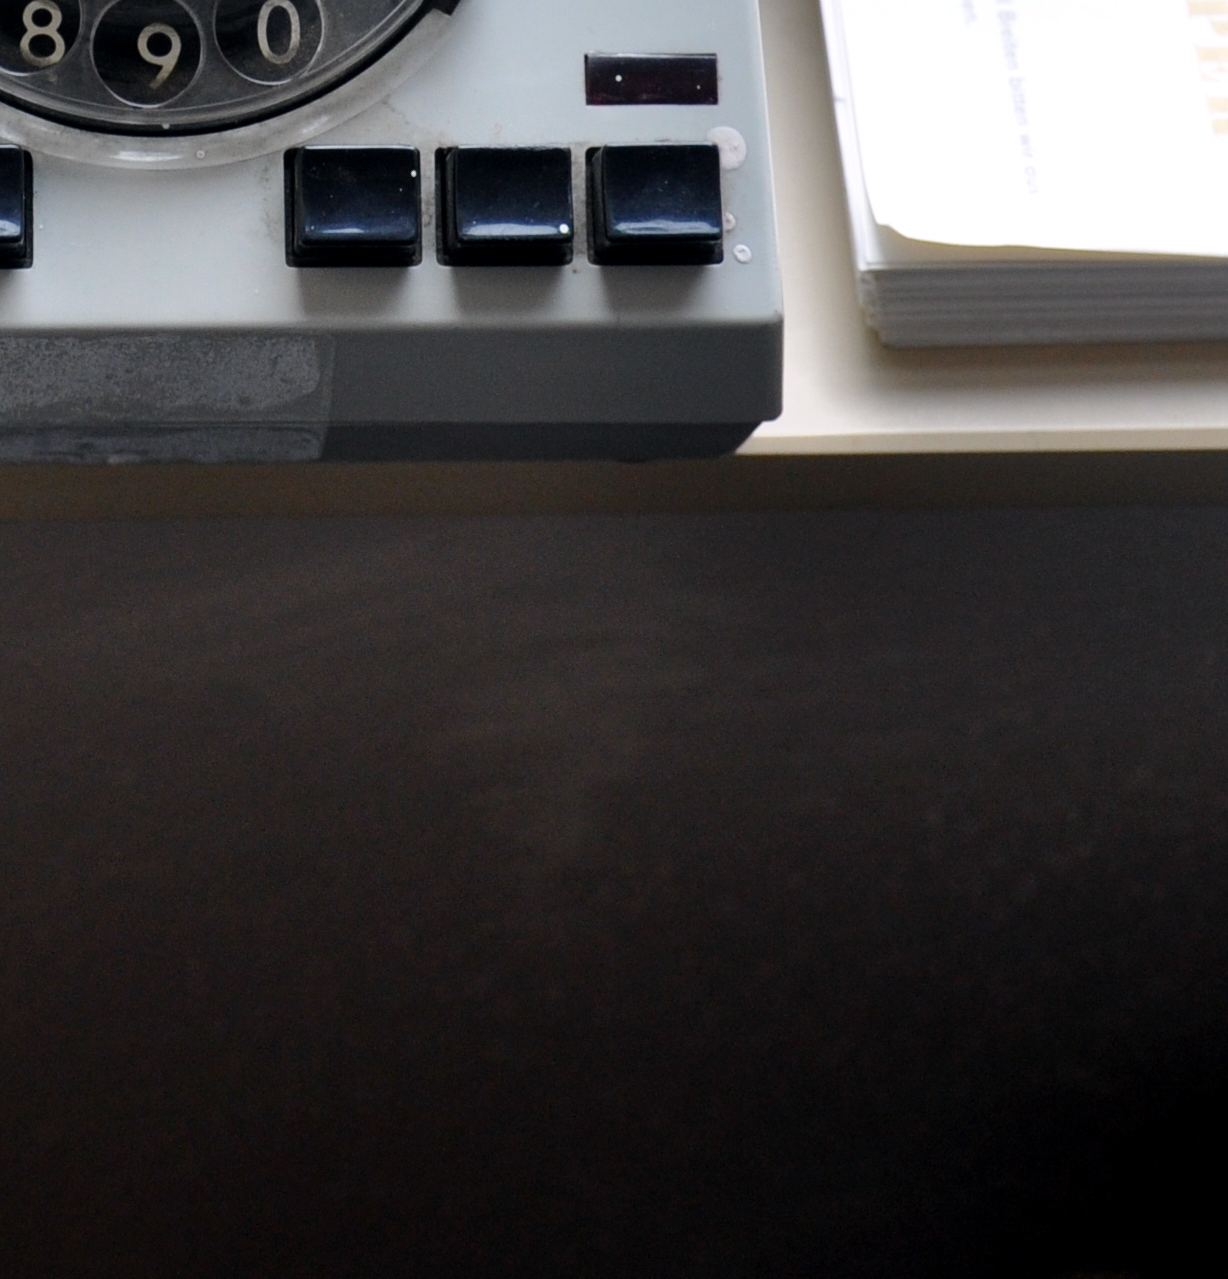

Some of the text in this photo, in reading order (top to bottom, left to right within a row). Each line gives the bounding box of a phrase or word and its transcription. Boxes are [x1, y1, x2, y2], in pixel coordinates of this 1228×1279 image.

[137, 23, 182, 88] 9
[997, 10, 1020, 70] Breiten
[1009, 76, 1028, 126] bitten
[1019, 133, 1034, 158] wir
